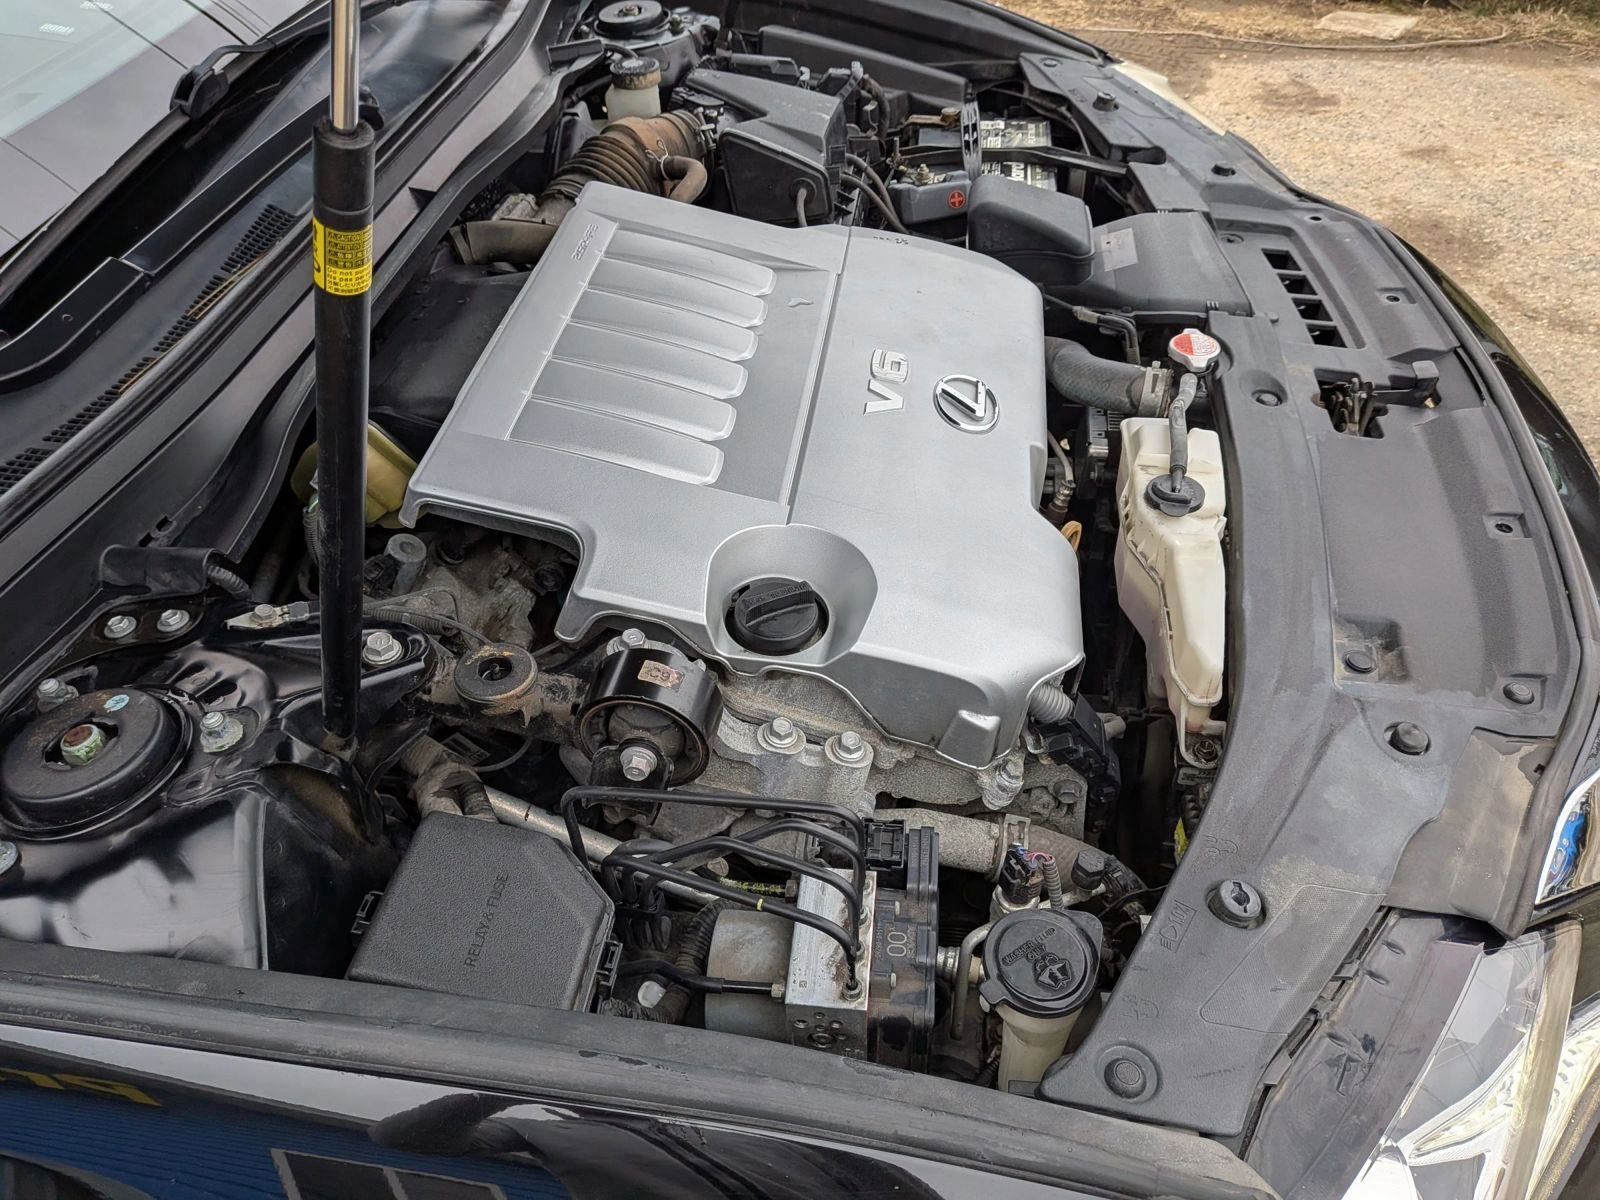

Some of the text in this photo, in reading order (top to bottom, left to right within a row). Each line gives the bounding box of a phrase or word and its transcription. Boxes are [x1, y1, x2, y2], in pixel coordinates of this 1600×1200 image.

[336, 233, 361, 242] CAUTION
[863, 349, 909, 415] V6
[463, 872, 509, 968] RELAY & FUSE
[1001, 939, 1035, 966] WASHER
